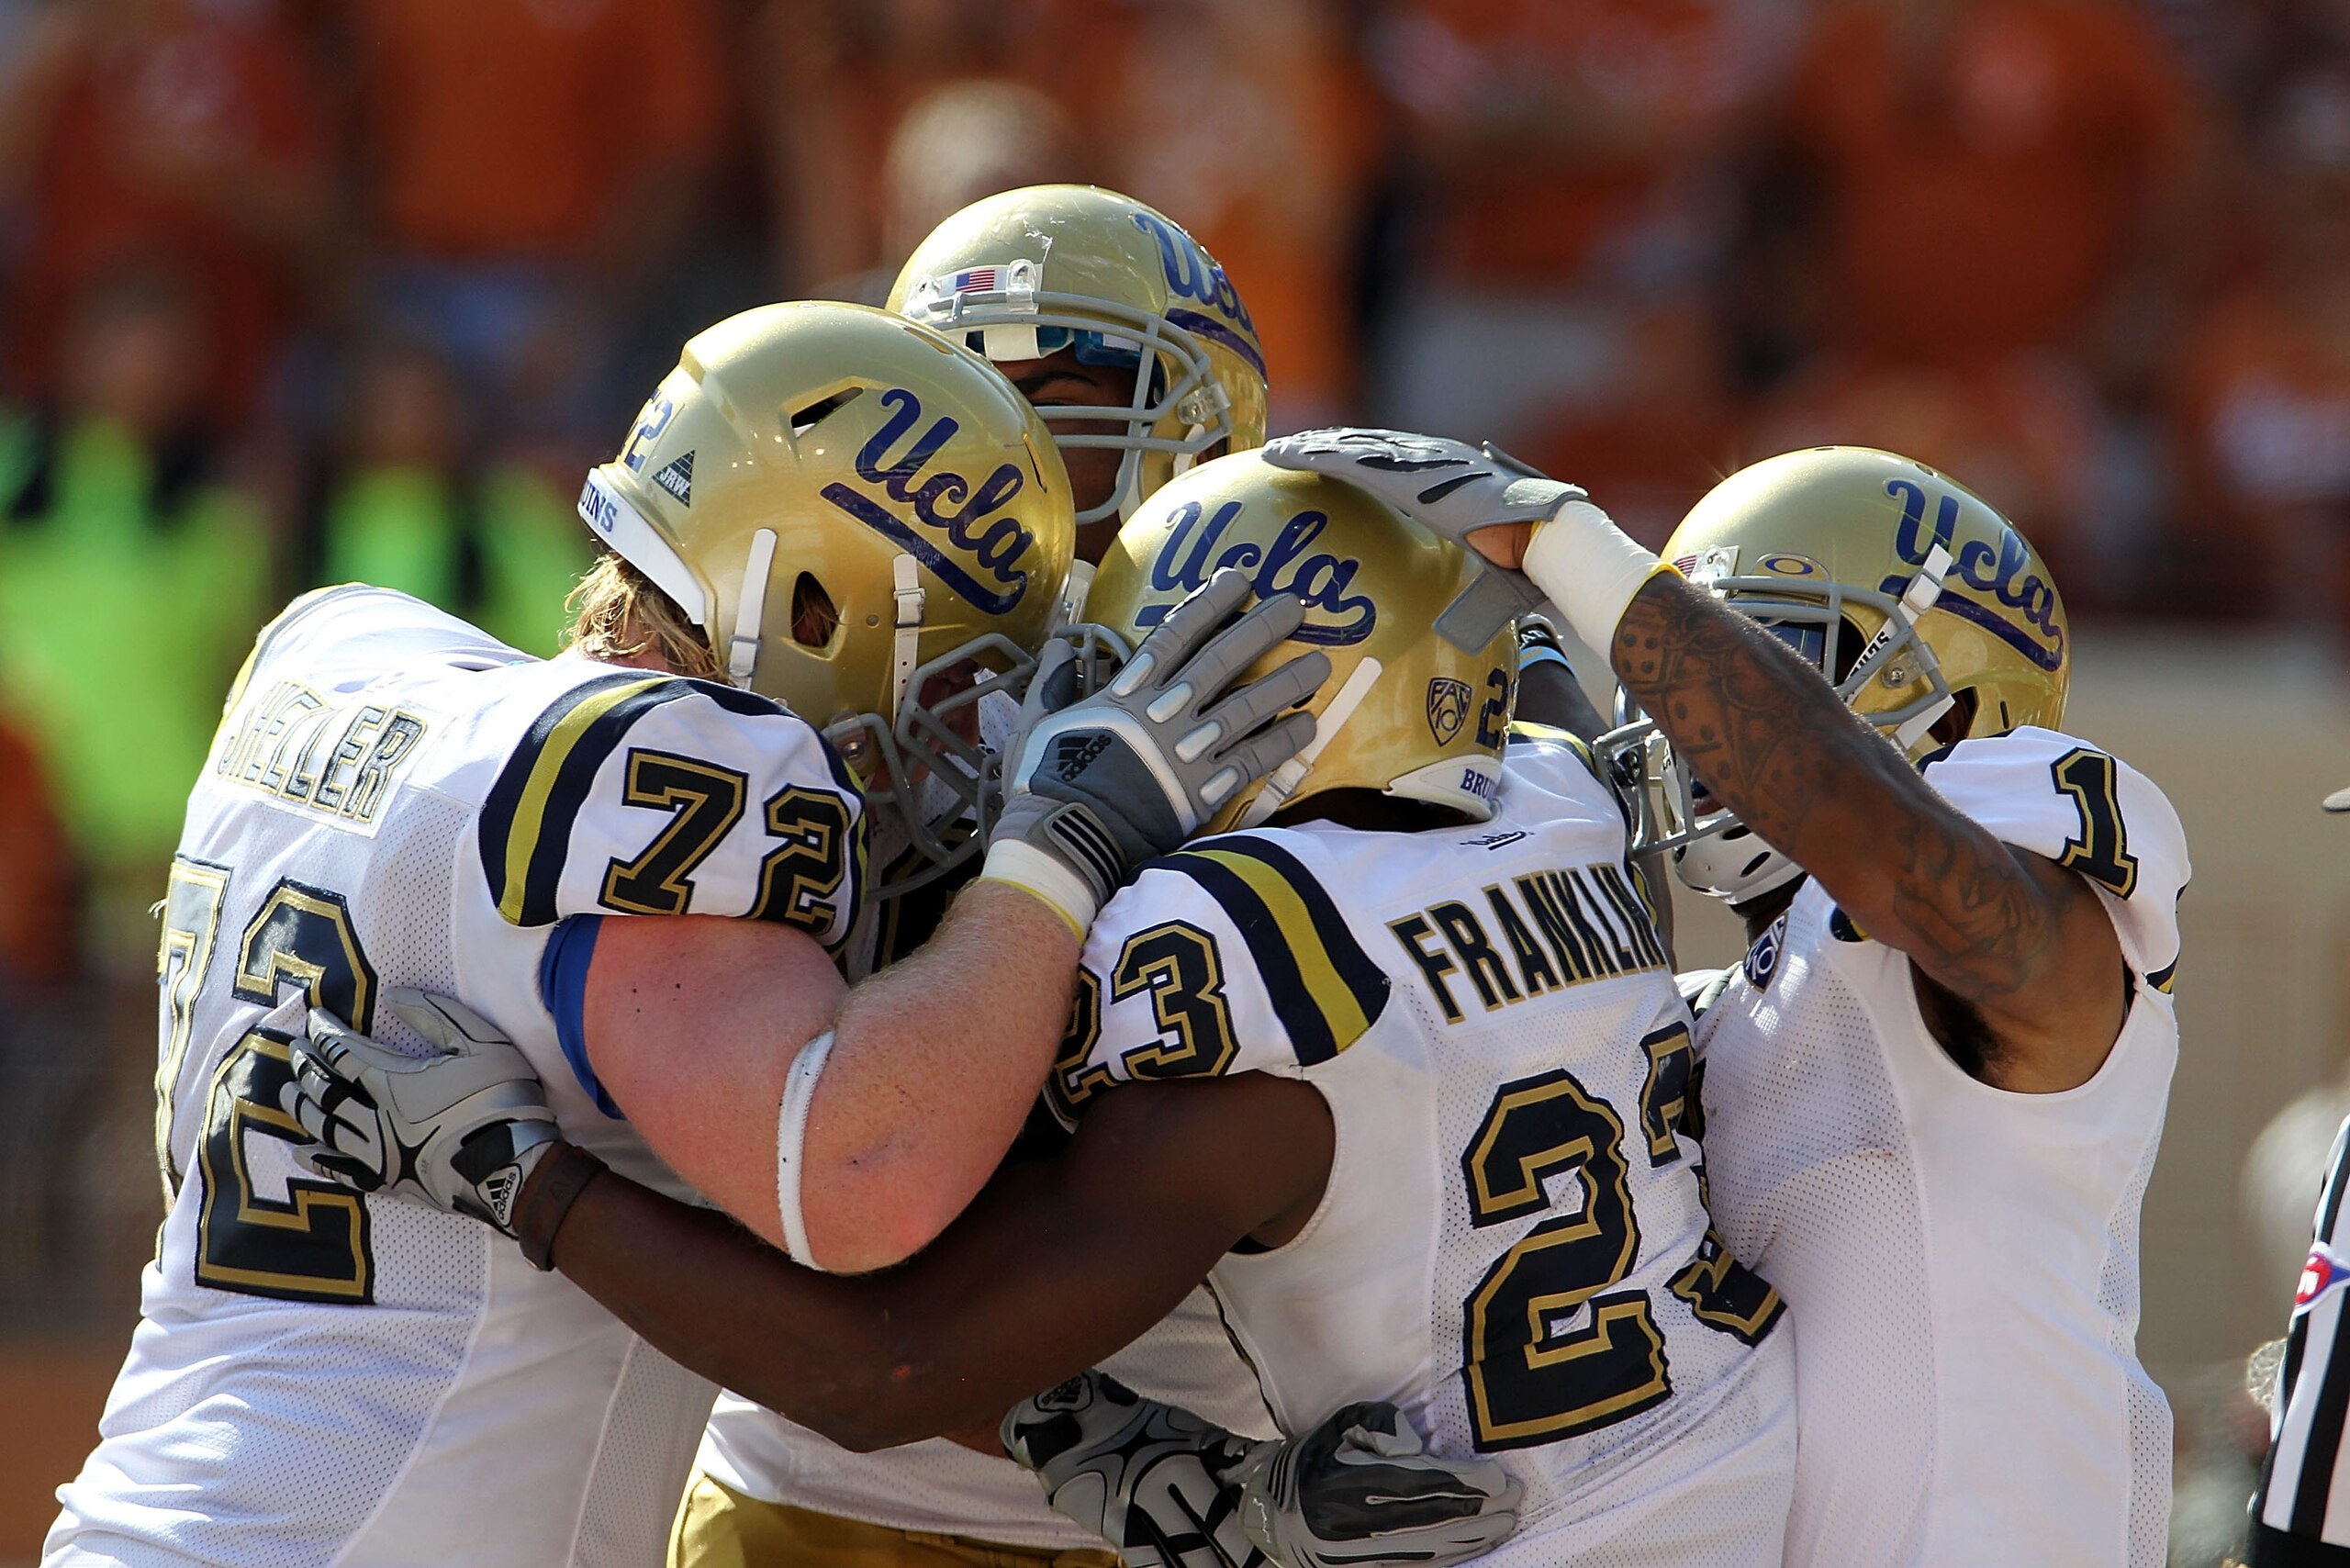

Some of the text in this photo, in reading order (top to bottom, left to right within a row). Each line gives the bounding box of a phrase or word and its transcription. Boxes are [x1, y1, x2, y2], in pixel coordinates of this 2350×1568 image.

[659, 465, 691, 497] JRW
[820, 387, 1035, 615] Ucla
[1136, 500, 1377, 646] Ucla
[1879, 479, 2065, 673] Ucla
[1061, 734, 1112, 782] adidas
[1435, 706, 1459, 732] 10
[598, 746, 854, 936] 72
[2049, 745, 2139, 902] 1
[497, 1171, 517, 1221] adidas
